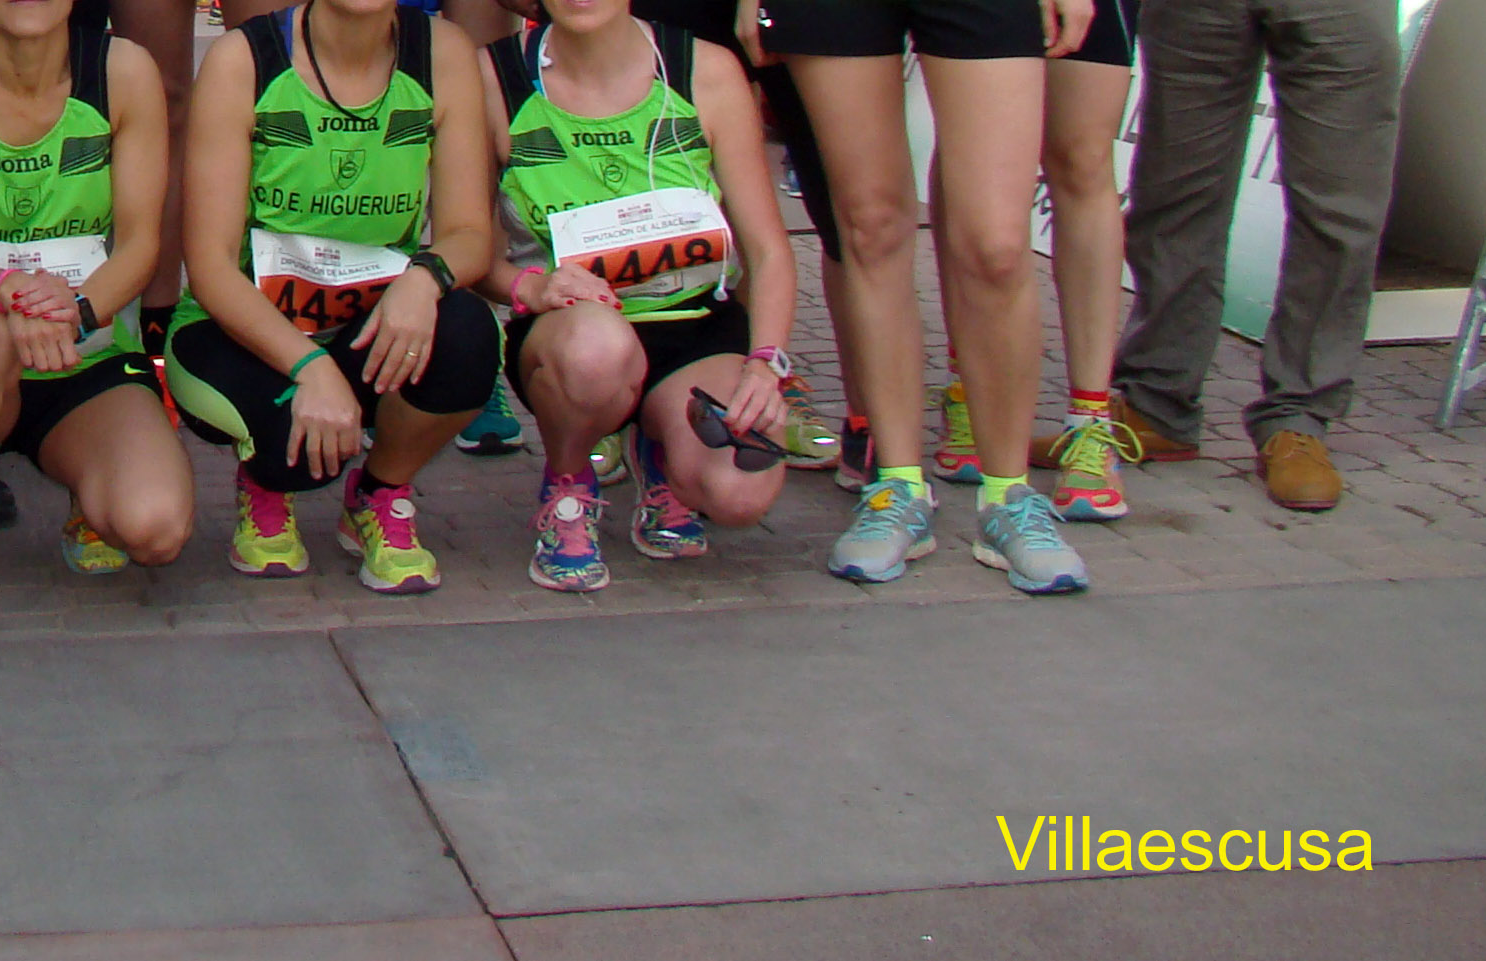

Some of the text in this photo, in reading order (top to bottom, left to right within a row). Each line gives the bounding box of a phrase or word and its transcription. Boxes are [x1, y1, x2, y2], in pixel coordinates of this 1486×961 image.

[317, 116, 380, 133] Joma
[571, 129, 635, 149] Joma
[636, 224, 648, 234] DE
[326, 267, 337, 276] DE
